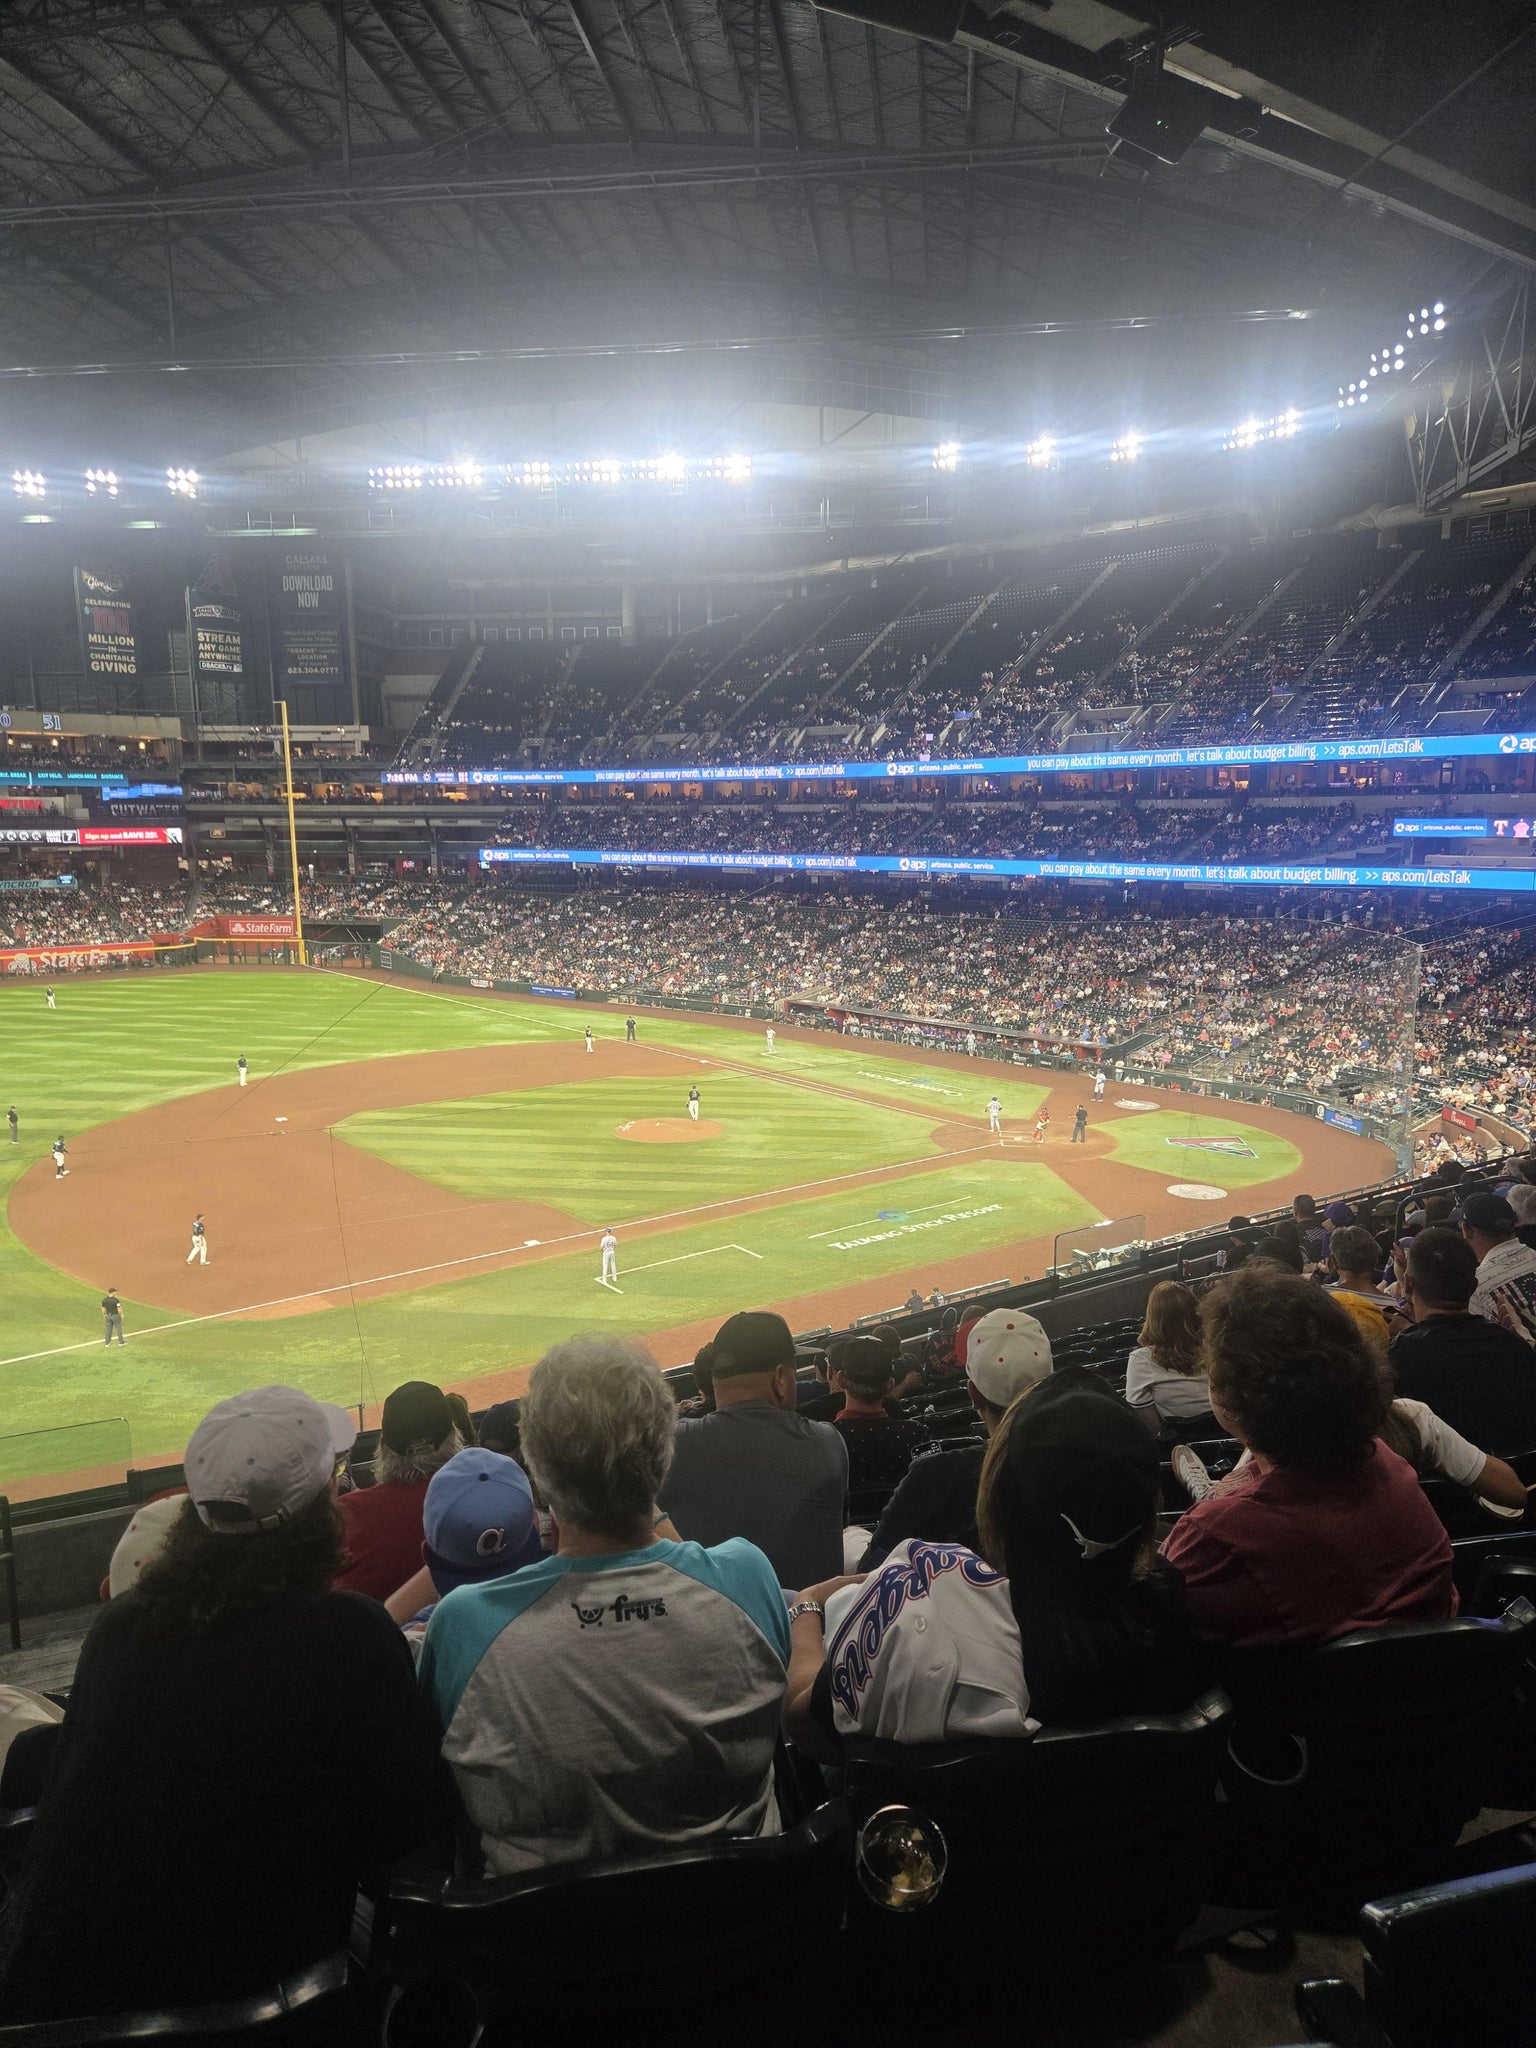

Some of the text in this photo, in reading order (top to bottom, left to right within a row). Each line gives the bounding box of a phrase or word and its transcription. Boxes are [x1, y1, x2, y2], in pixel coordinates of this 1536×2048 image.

[283, 575, 333, 591] DOWNLOAD
[84, 598, 131, 609] CELEBRATING
[297, 591, 319, 608] NOW
[88, 633, 135, 647] MILLION
[197, 632, 241, 645] STREAM
[198, 643, 241, 654] ANY GAME
[90, 653, 136, 662] CHARITABLE
[199, 652, 242, 662] ANYWHERE
[91, 661, 137, 674] GIVING
[42, 714, 62, 731] 51
[1027, 738, 1424, 771] you can pay about the same every month. let's talk about budget billing. aps.com/LetsTalk
[595, 772, 605, 782] you
[615, 772, 625, 781] pay
[625, 770, 640, 779] about
[650, 771, 664, 779] same
[665, 770, 681, 781] every
[681, 768, 701, 778] month.
[702, 768, 714, 778] let's
[714, 767, 725, 777] talk
[726, 767, 743, 777] about
[743, 766, 764, 779] budget
[765, 766, 784, 779] billing.
[795, 765, 845, 778] aps.com/LetsTalk
[897, 764, 915, 776] aps
[404, 773, 418, 783] PM
[483, 774, 499, 783] aps
[1405, 823, 1419, 832] aps
[494, 851, 509, 861] aps
[601, 853, 857, 868] you can pay about the same every month. let's talk about budget billing. aps.com/LetsTalk
[910, 860, 927, 870] aps
[1040, 863, 1471, 886] you can pay about the same every month. let's talk about budget billing. aps.com/LetsTalk
[827, 1203, 1004, 1250] TALKING STICK RESORT
